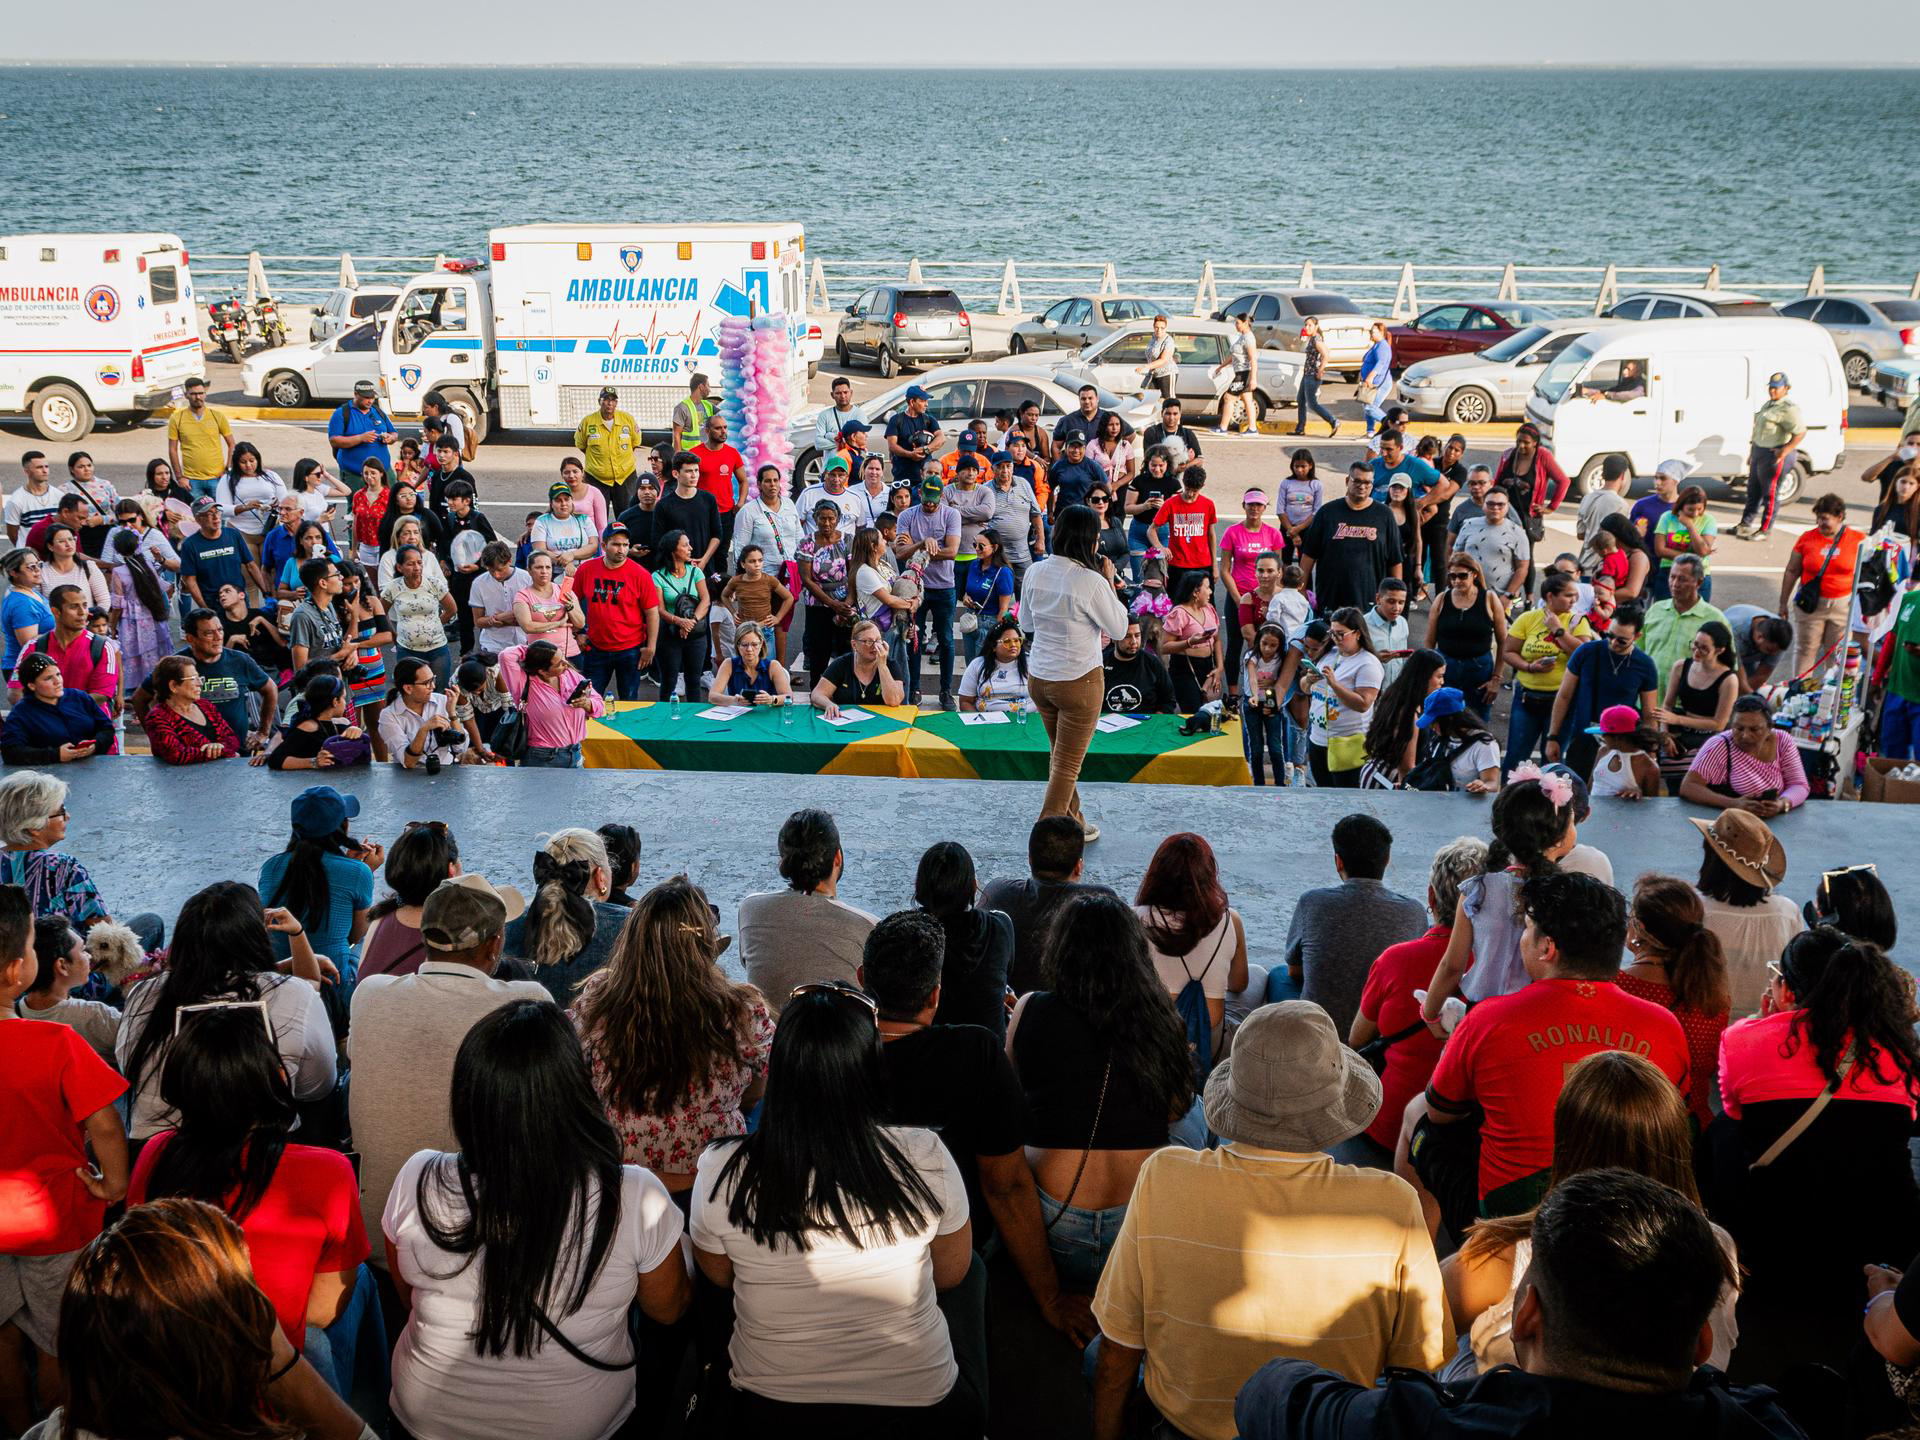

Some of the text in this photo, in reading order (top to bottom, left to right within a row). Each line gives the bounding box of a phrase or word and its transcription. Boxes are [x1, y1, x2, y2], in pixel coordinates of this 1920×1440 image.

[566, 278, 698, 301] AMBULANCIA
[601, 358, 680, 373] BOMBEROS
[537, 370, 549, 380] 57
[1173, 523, 1205, 537] STRONG
[1527, 1023, 1652, 1058] RONALDO
